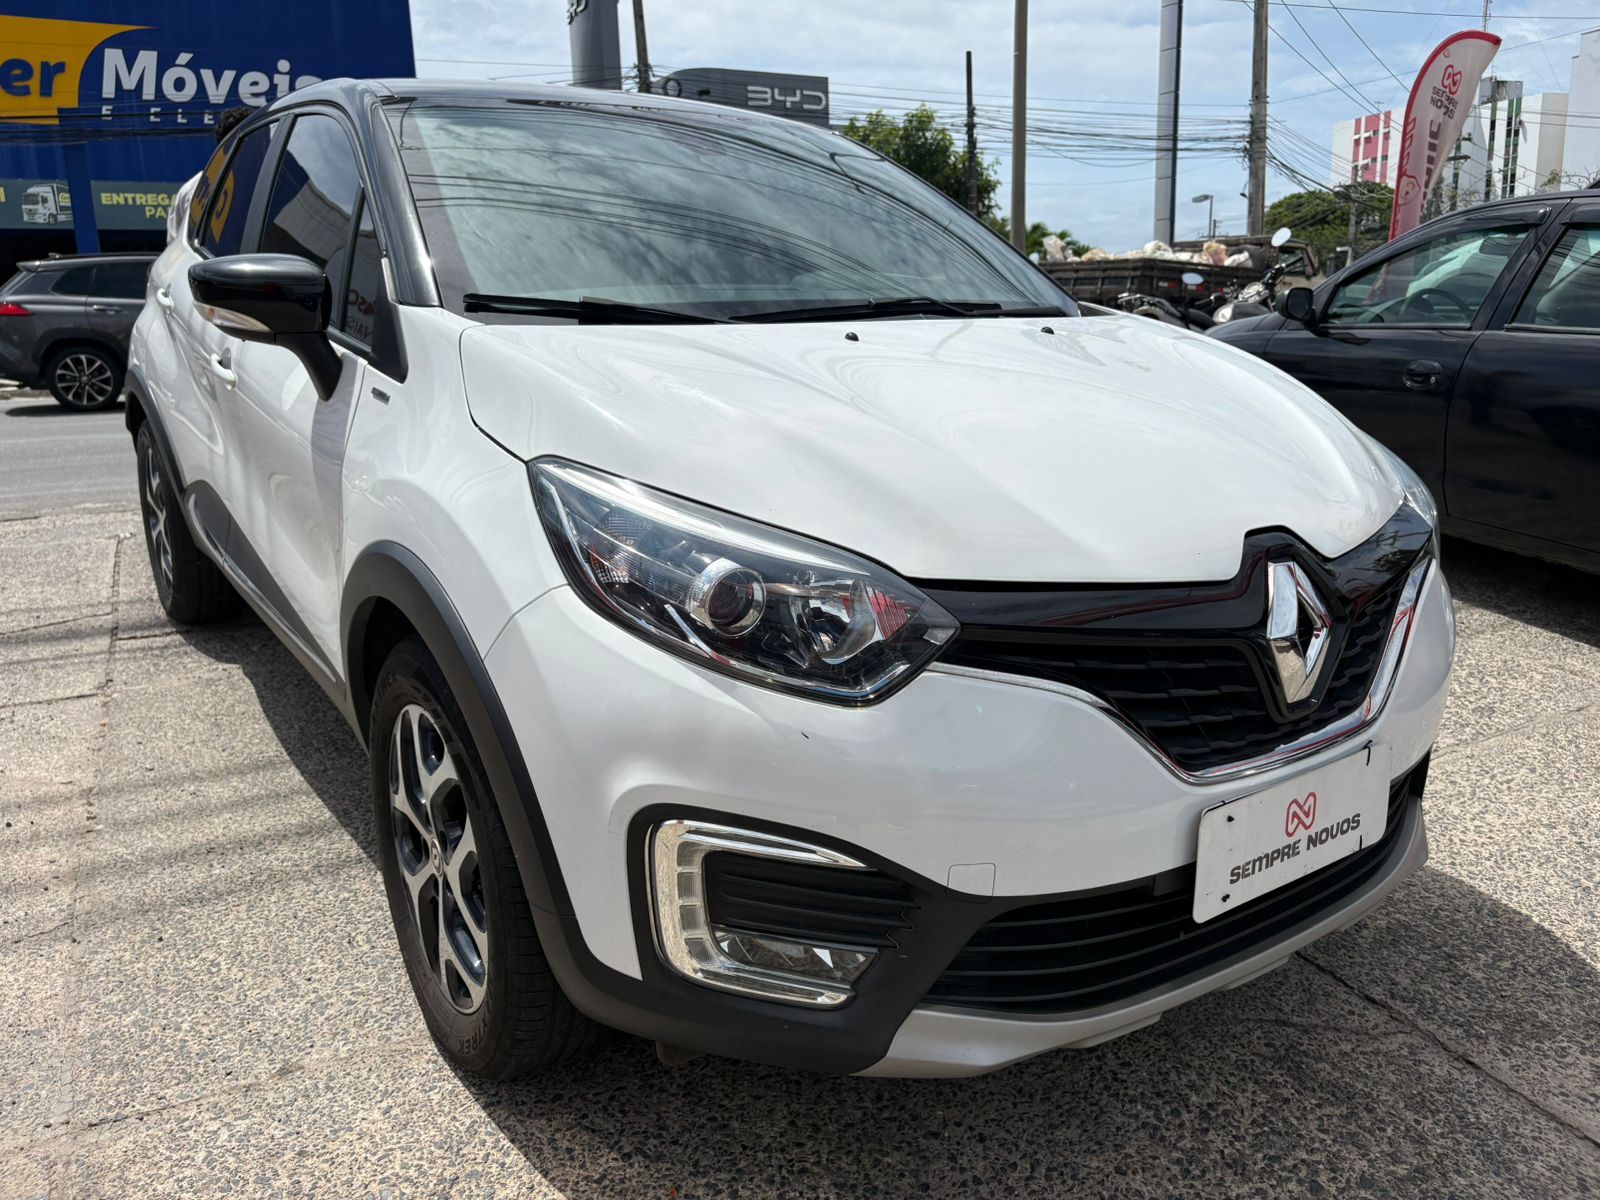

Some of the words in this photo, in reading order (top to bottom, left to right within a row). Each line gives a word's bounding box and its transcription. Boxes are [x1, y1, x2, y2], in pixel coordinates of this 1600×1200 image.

[747, 85, 827, 110] BYD
[145, 206, 172, 218] PA
[1229, 838, 1302, 885] SEMPRE
